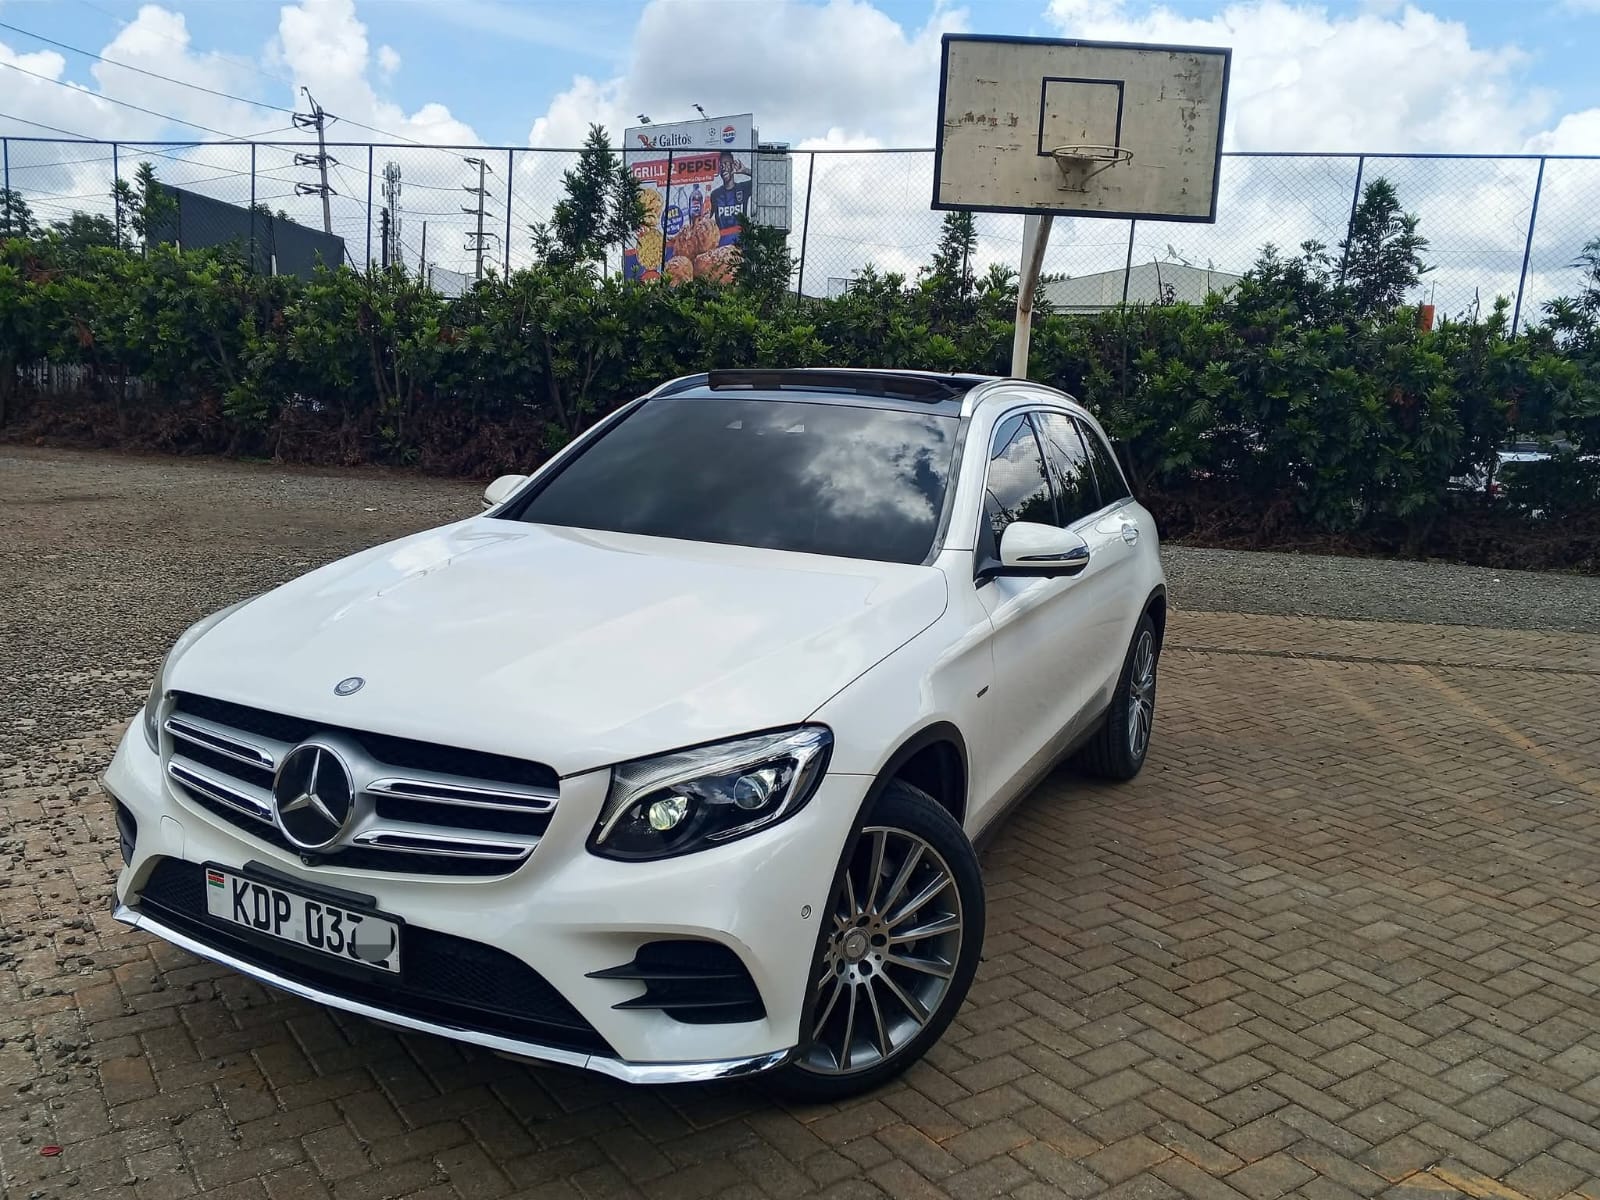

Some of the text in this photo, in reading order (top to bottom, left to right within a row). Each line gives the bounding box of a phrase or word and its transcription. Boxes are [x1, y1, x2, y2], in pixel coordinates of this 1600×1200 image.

[659, 133, 692, 147] Galito's
[634, 165, 665, 178] GRILL
[678, 158, 717, 174] PEPSI
[718, 203, 744, 217] PEPSI
[232, 877, 291, 935] KDP
